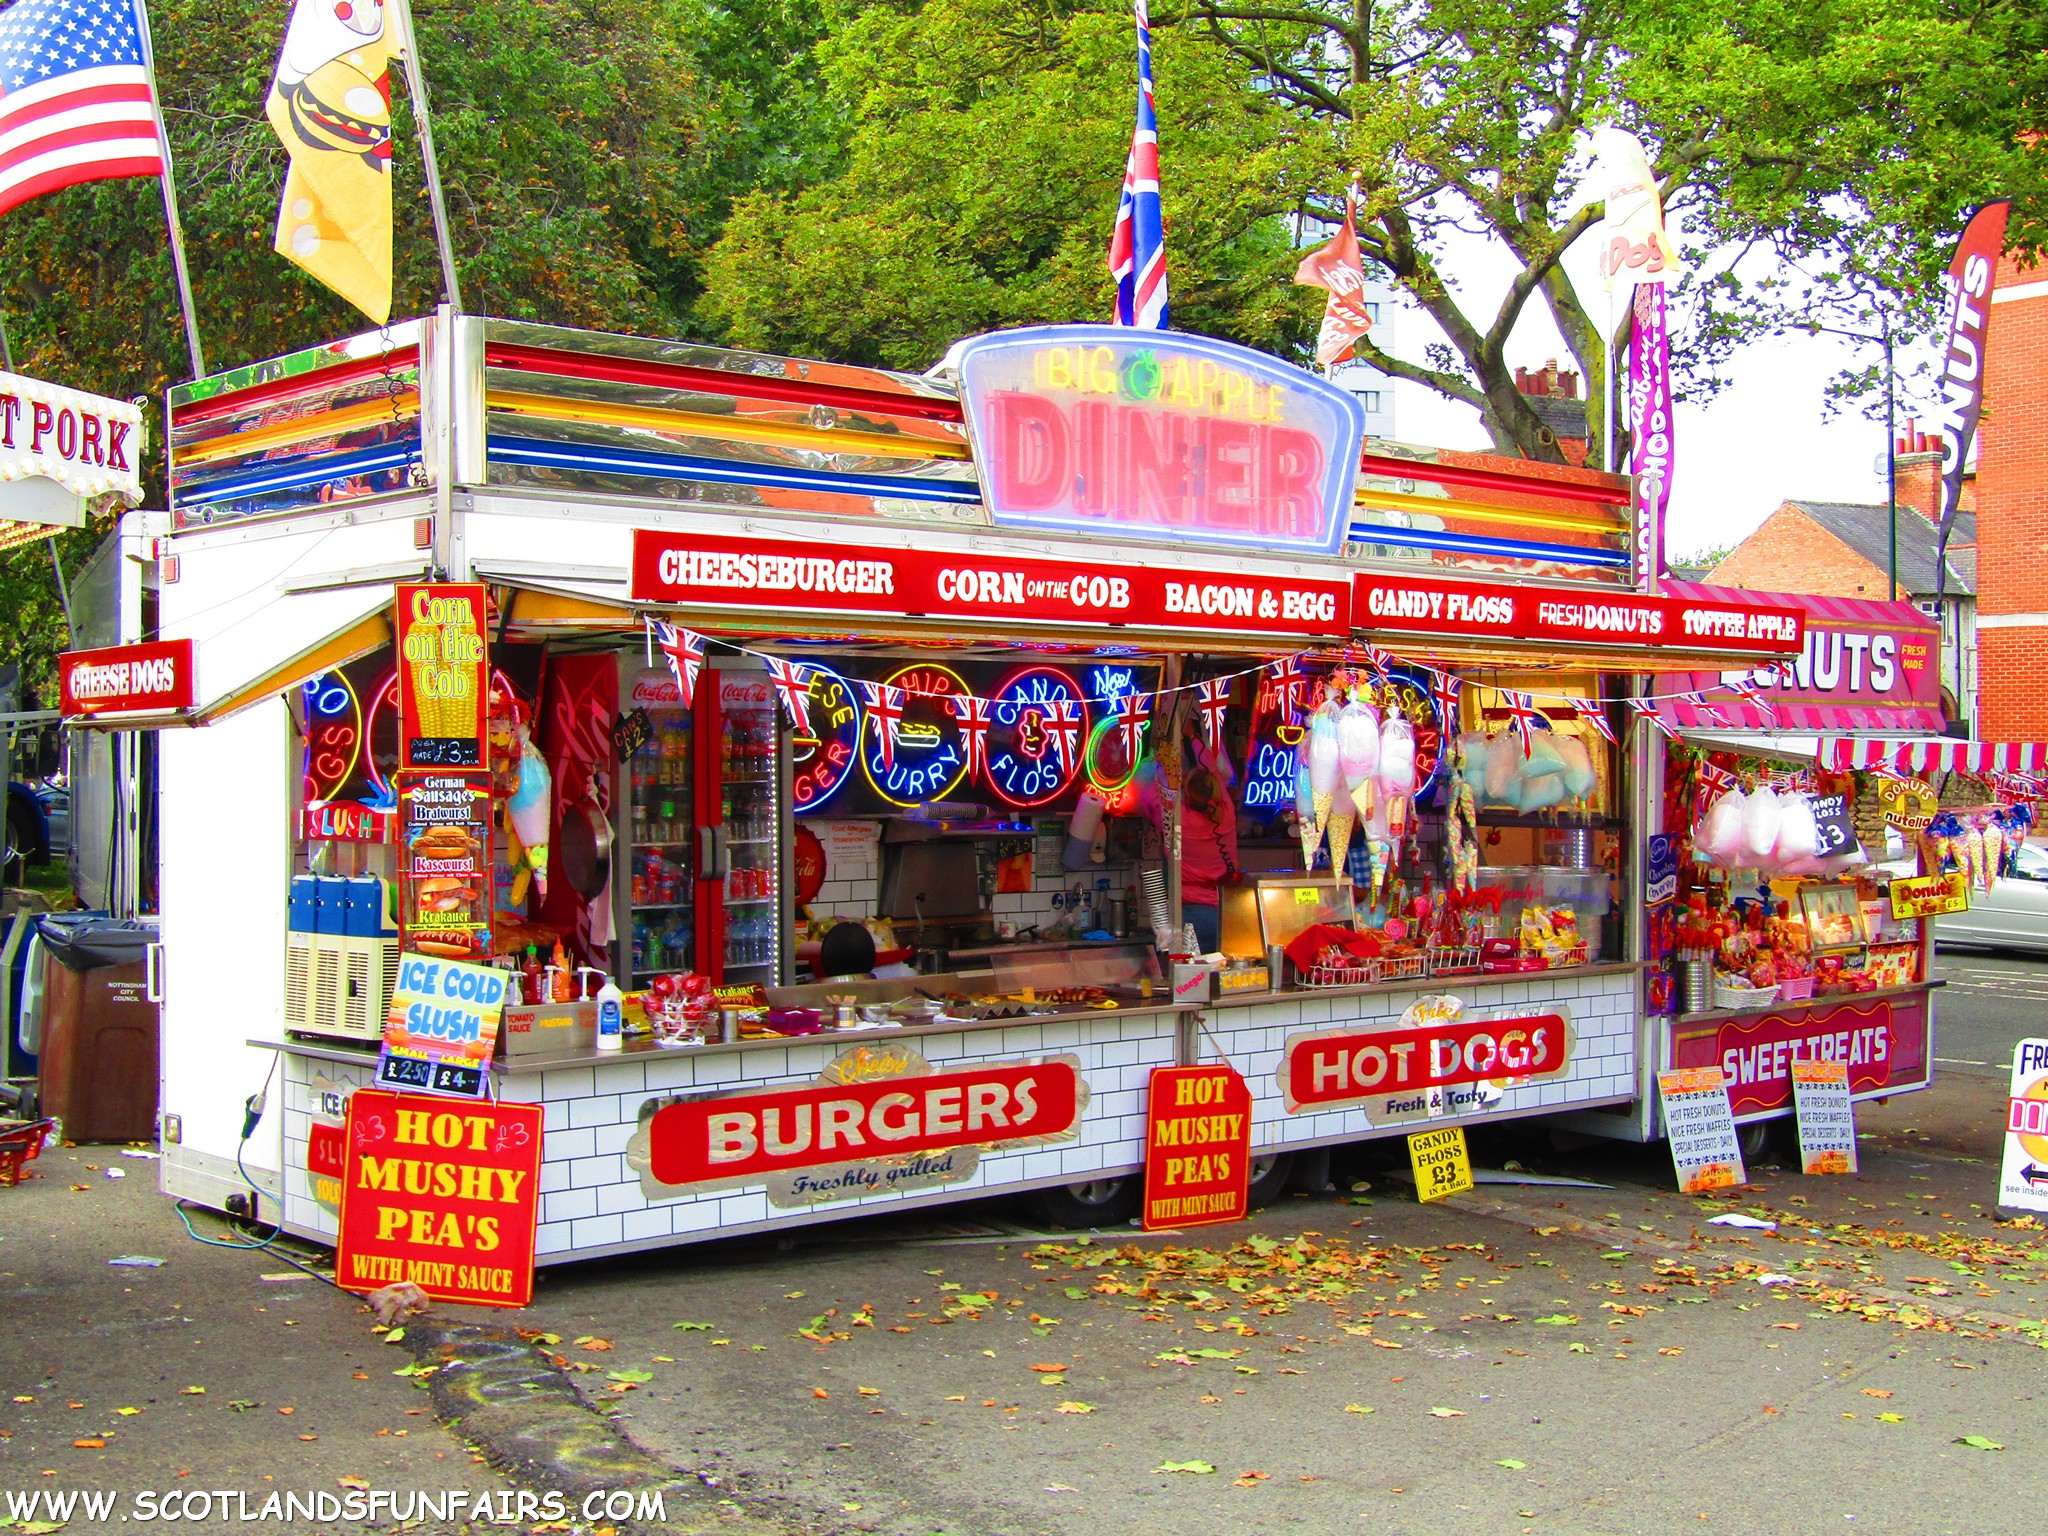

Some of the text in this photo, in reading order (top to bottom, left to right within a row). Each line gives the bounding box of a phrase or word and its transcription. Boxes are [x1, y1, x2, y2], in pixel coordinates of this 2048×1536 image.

[1035, 345, 1286, 422] BIG APPLE
[31, 401, 130, 472] PORK
[985, 390, 1325, 537] DINER
[658, 548, 895, 596] CHEESEBURGER
[937, 568, 1131, 609] CORN ON THE COB
[1165, 581, 1336, 622] BACON & EGG
[411, 589, 472, 625] Corn
[1368, 588, 1513, 624] CANDY FLOSS
[1539, 602, 1662, 634] FRESH DONUTS
[1682, 608, 1797, 641] TOFFEE APPLE
[404, 625, 484, 662] on the
[1902, 644, 1927, 656] FRESH
[1720, 630, 1895, 693] NUTS
[1903, 659, 1925, 670] MADE
[69, 657, 175, 700] CHEESE DOGS
[419, 663, 469, 698] Cob
[722, 682, 768, 702] Coca-Cola
[808, 672, 854, 728] ESE
[997, 677, 1067, 725] CAND
[625, 727, 648, 757] £2
[795, 743, 852, 802] GER
[873, 745, 962, 795] CURRY
[992, 754, 1060, 795] FLOS
[1258, 743, 1295, 777] COL
[424, 776, 465, 788] German
[1244, 780, 1297, 805] DRIN
[1884, 780, 1934, 802] DONUTS
[411, 788, 476, 806] Sausages
[1812, 795, 1843, 811] ANDY
[309, 808, 373, 838] SLUSH
[414, 806, 471, 820] Bratwurst
[1816, 807, 1841, 819] LOSS
[1884, 810, 1933, 830] nutella
[414, 857, 474, 872] Kasewurst
[1648, 862, 1676, 881] Chocolate
[1648, 878, 1674, 898] Covered
[419, 910, 470, 923] Krakauer
[1897, 904, 1906, 915] 4
[400, 961, 502, 1005] ICE COLD
[713, 985, 755, 998] Krakauer
[1175, 971, 1206, 995] Vinegar
[1222, 972, 1267, 989] CHIPS
[407, 1002, 481, 1042] SLUSH
[507, 1013, 535, 1024] TOMATO
[508, 1023, 531, 1033] SAUCE
[391, 1045, 481, 1069] SMALL LARGE
[839, 1046, 909, 1083] Cheese
[1313, 1027, 1549, 1093] HOT DOGS
[1723, 1039, 1803, 1088] SWEET
[1807, 1026, 1888, 1064] TREATS
[321, 1092, 340, 1116] ICE
[1175, 1077, 1228, 1106] HOT
[1386, 1089, 1488, 1114] Fresh & Tasty
[1801, 1097, 1847, 1108] HOT FRESH DONUTS
[707, 1077, 1039, 1165] BURGERS
[1670, 1104, 1726, 1122] HOT FRESH DONUTS
[1800, 1112, 1850, 1123] NICE FRESH WAFFLES
[354, 1115, 387, 1147] £3
[394, 1108, 496, 1151] HOT
[496, 1123, 531, 1152] £3
[1156, 1113, 1244, 1148] MUSHY
[1413, 1129, 1458, 1151] CANDY
[1671, 1119, 1731, 1138] NICE FRESH WAFFLES
[1801, 1127, 1850, 1138] SPECIAL DESSERTS DAILY
[1417, 1145, 1462, 1167] FLOSS
[1675, 1135, 1733, 1155] SPECIAL DESSERTS DAILY
[357, 1155, 527, 1204] MUSHY
[790, 1154, 953, 1196] Freshly grilled
[1164, 1153, 1230, 1187] PEA'S
[1432, 1162, 1456, 1186] £3
[1702, 1168, 1733, 1178] CATERING
[1429, 1187, 1438, 1195] IN
[1450, 1179, 1467, 1189] BAG
[2005, 1184, 2020, 1194] see
[1152, 1191, 1237, 1220] WITH MINT SAUCE
[376, 1205, 500, 1251] PEA'S
[351, 1254, 513, 1294] WITH MINT SAUCE
